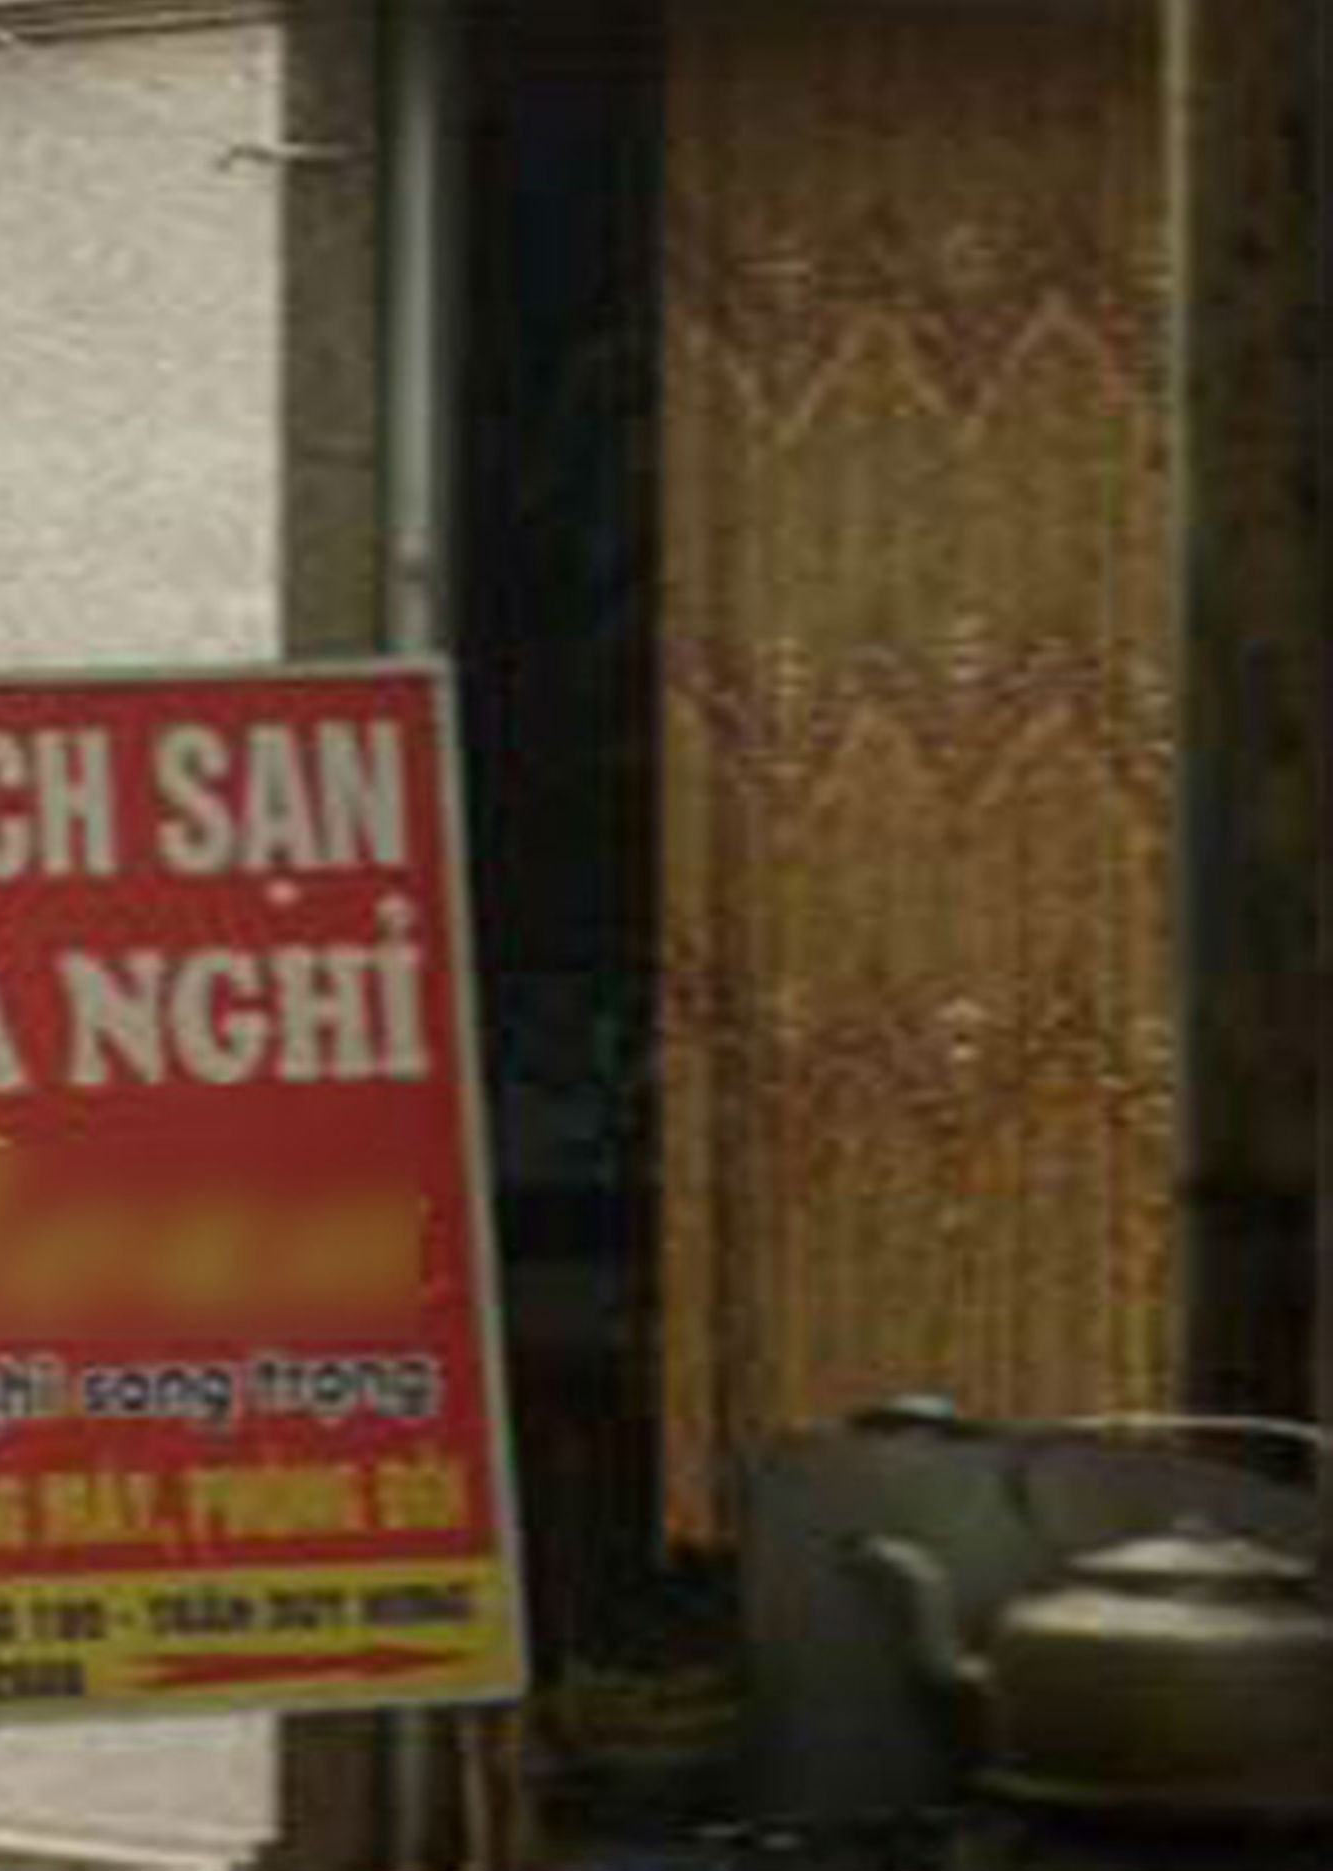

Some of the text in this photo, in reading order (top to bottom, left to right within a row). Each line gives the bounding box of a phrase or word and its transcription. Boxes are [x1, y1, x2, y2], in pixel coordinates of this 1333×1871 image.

[154, 718, 410, 908] SẠN
[57, 894, 433, 1088] NGHỈ
[79, 1358, 237, 1430] sang
